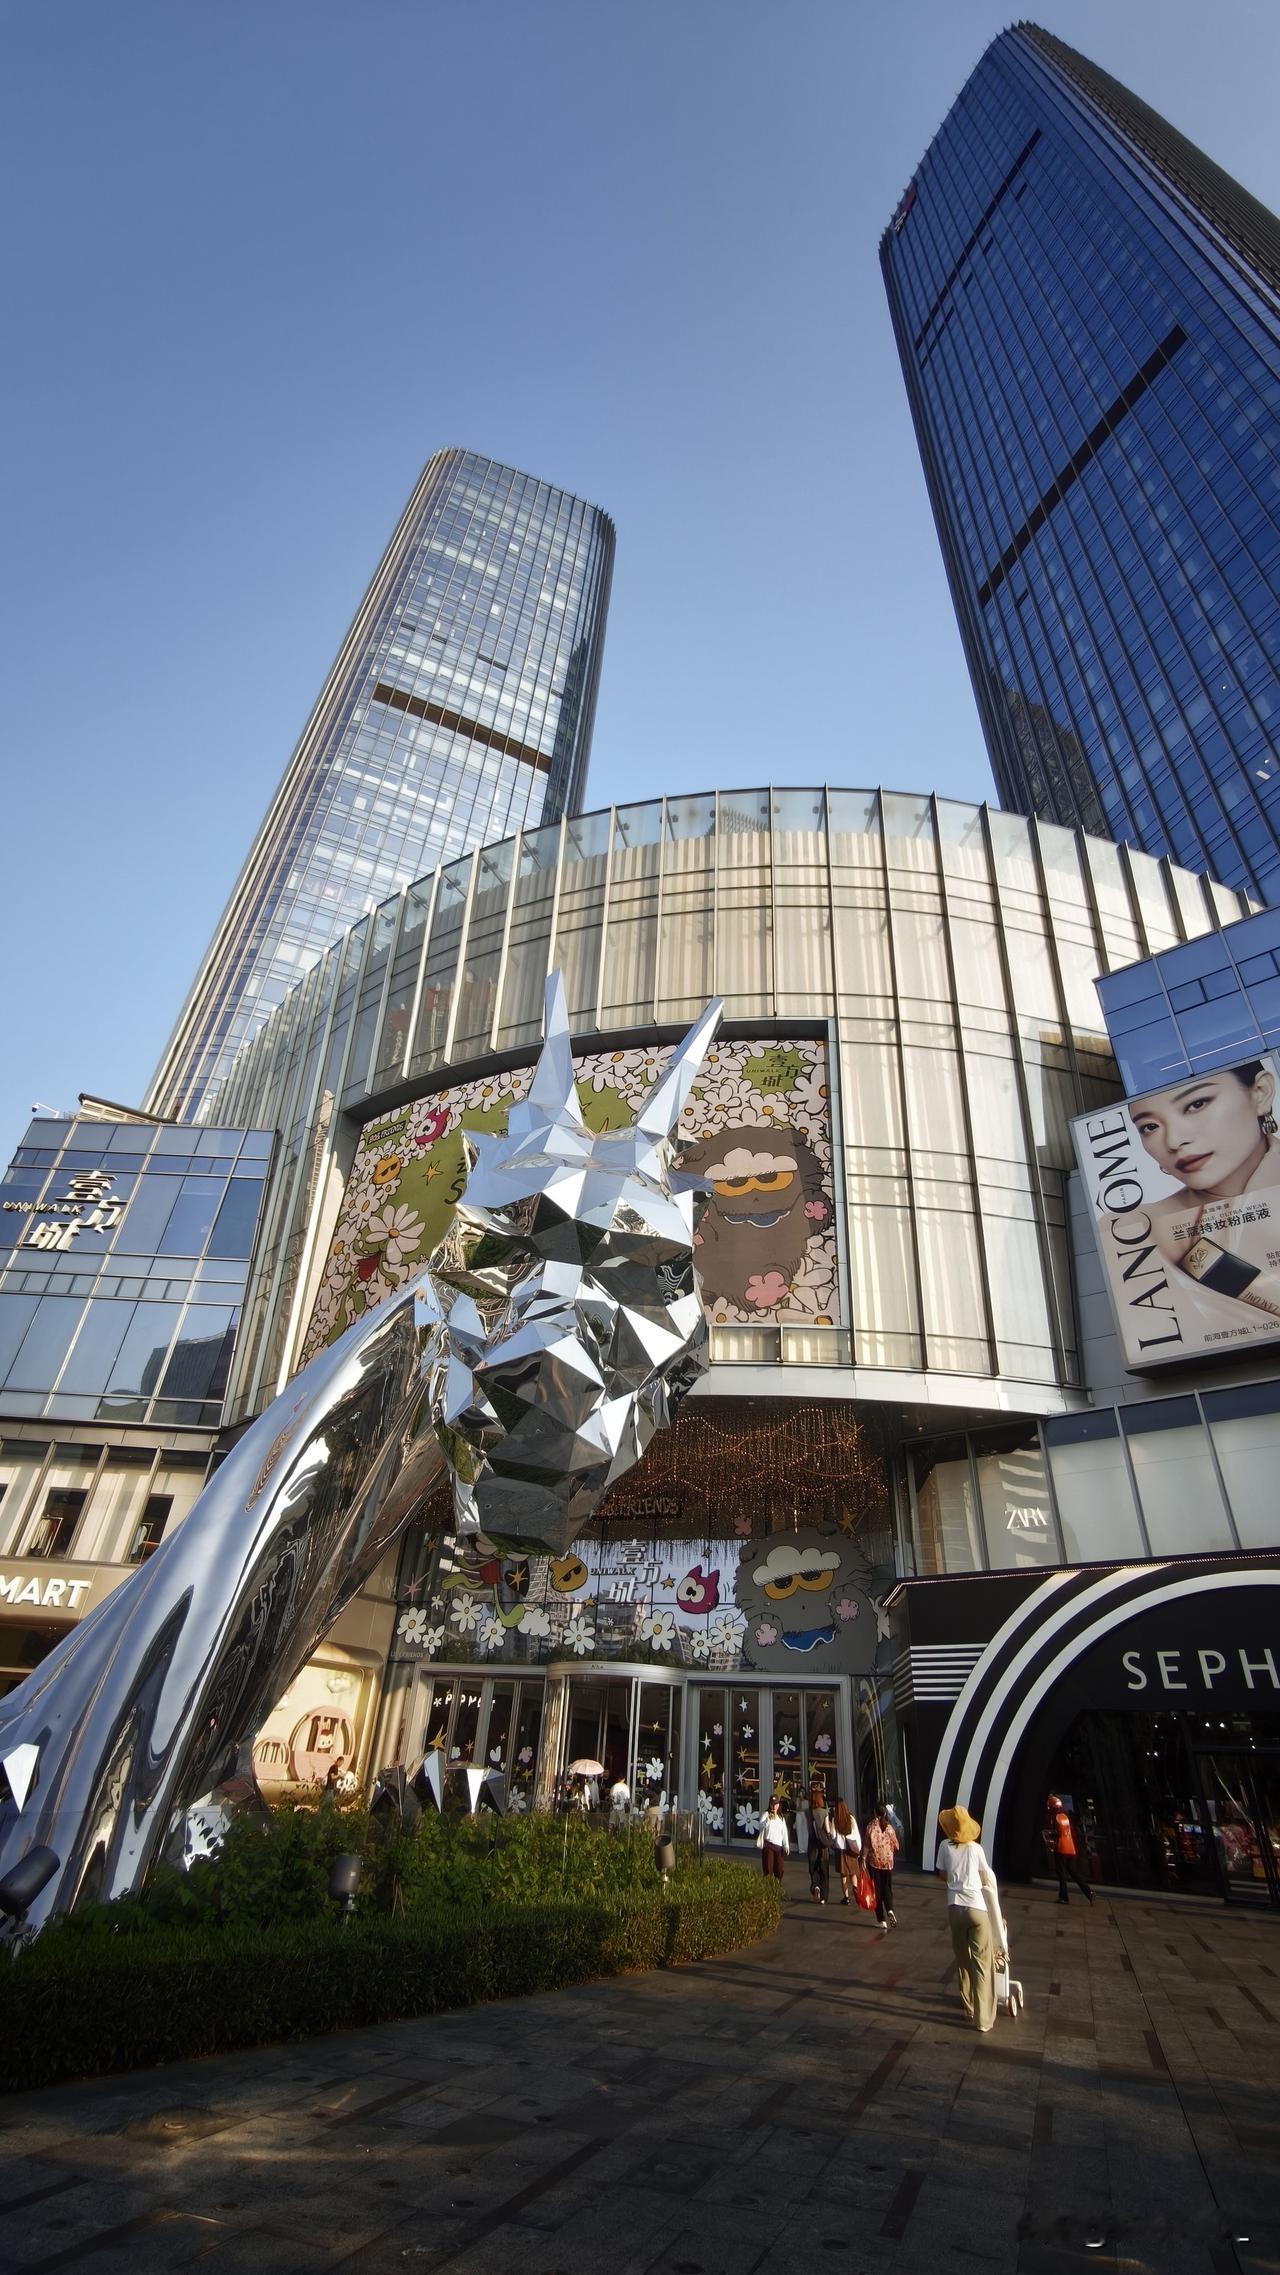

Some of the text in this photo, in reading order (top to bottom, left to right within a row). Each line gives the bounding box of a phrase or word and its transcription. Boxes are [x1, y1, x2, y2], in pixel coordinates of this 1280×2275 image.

[1086, 1111, 1183, 1351] LANCÔME
[1173, 1207, 1271, 1241] 兰蔻持妆粉底液
[1004, 1507, 1047, 1529] ZARA
[591, 1567, 636, 1575] UNIWALK
[0, 1575, 91, 1608] MART
[1122, 1648, 1280, 1690] SEPH
